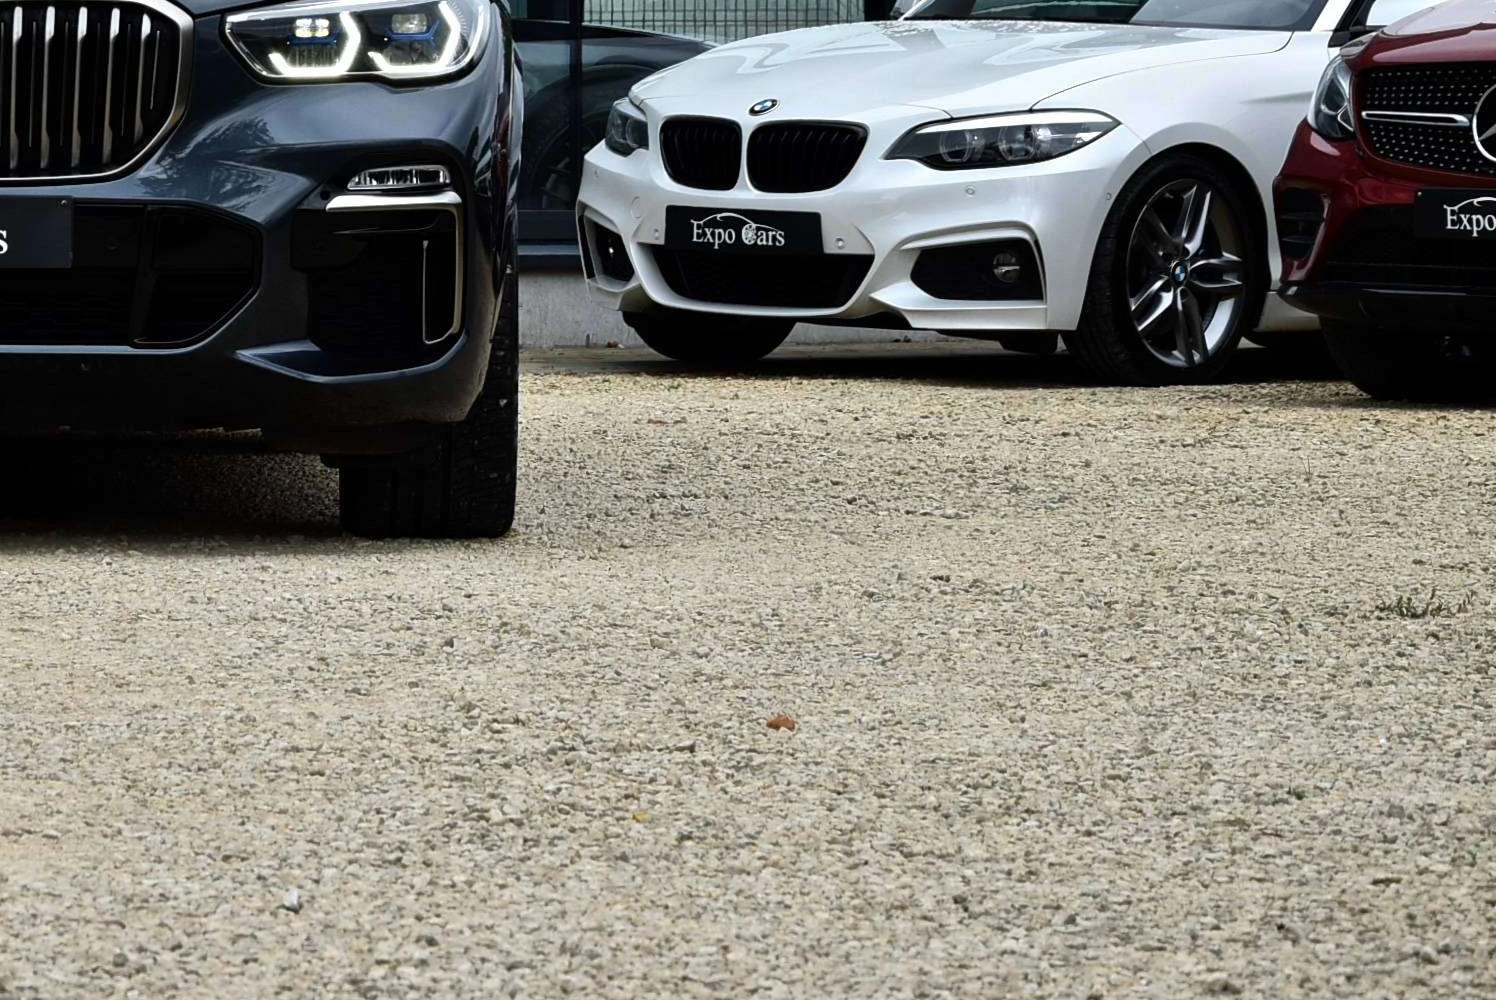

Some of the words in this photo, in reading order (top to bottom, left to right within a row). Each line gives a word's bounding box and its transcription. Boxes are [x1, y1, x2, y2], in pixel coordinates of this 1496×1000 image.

[691, 220, 736, 249] Expo
[742, 223, 785, 246] Cars
[1444, 205, 1496, 237] Expo
